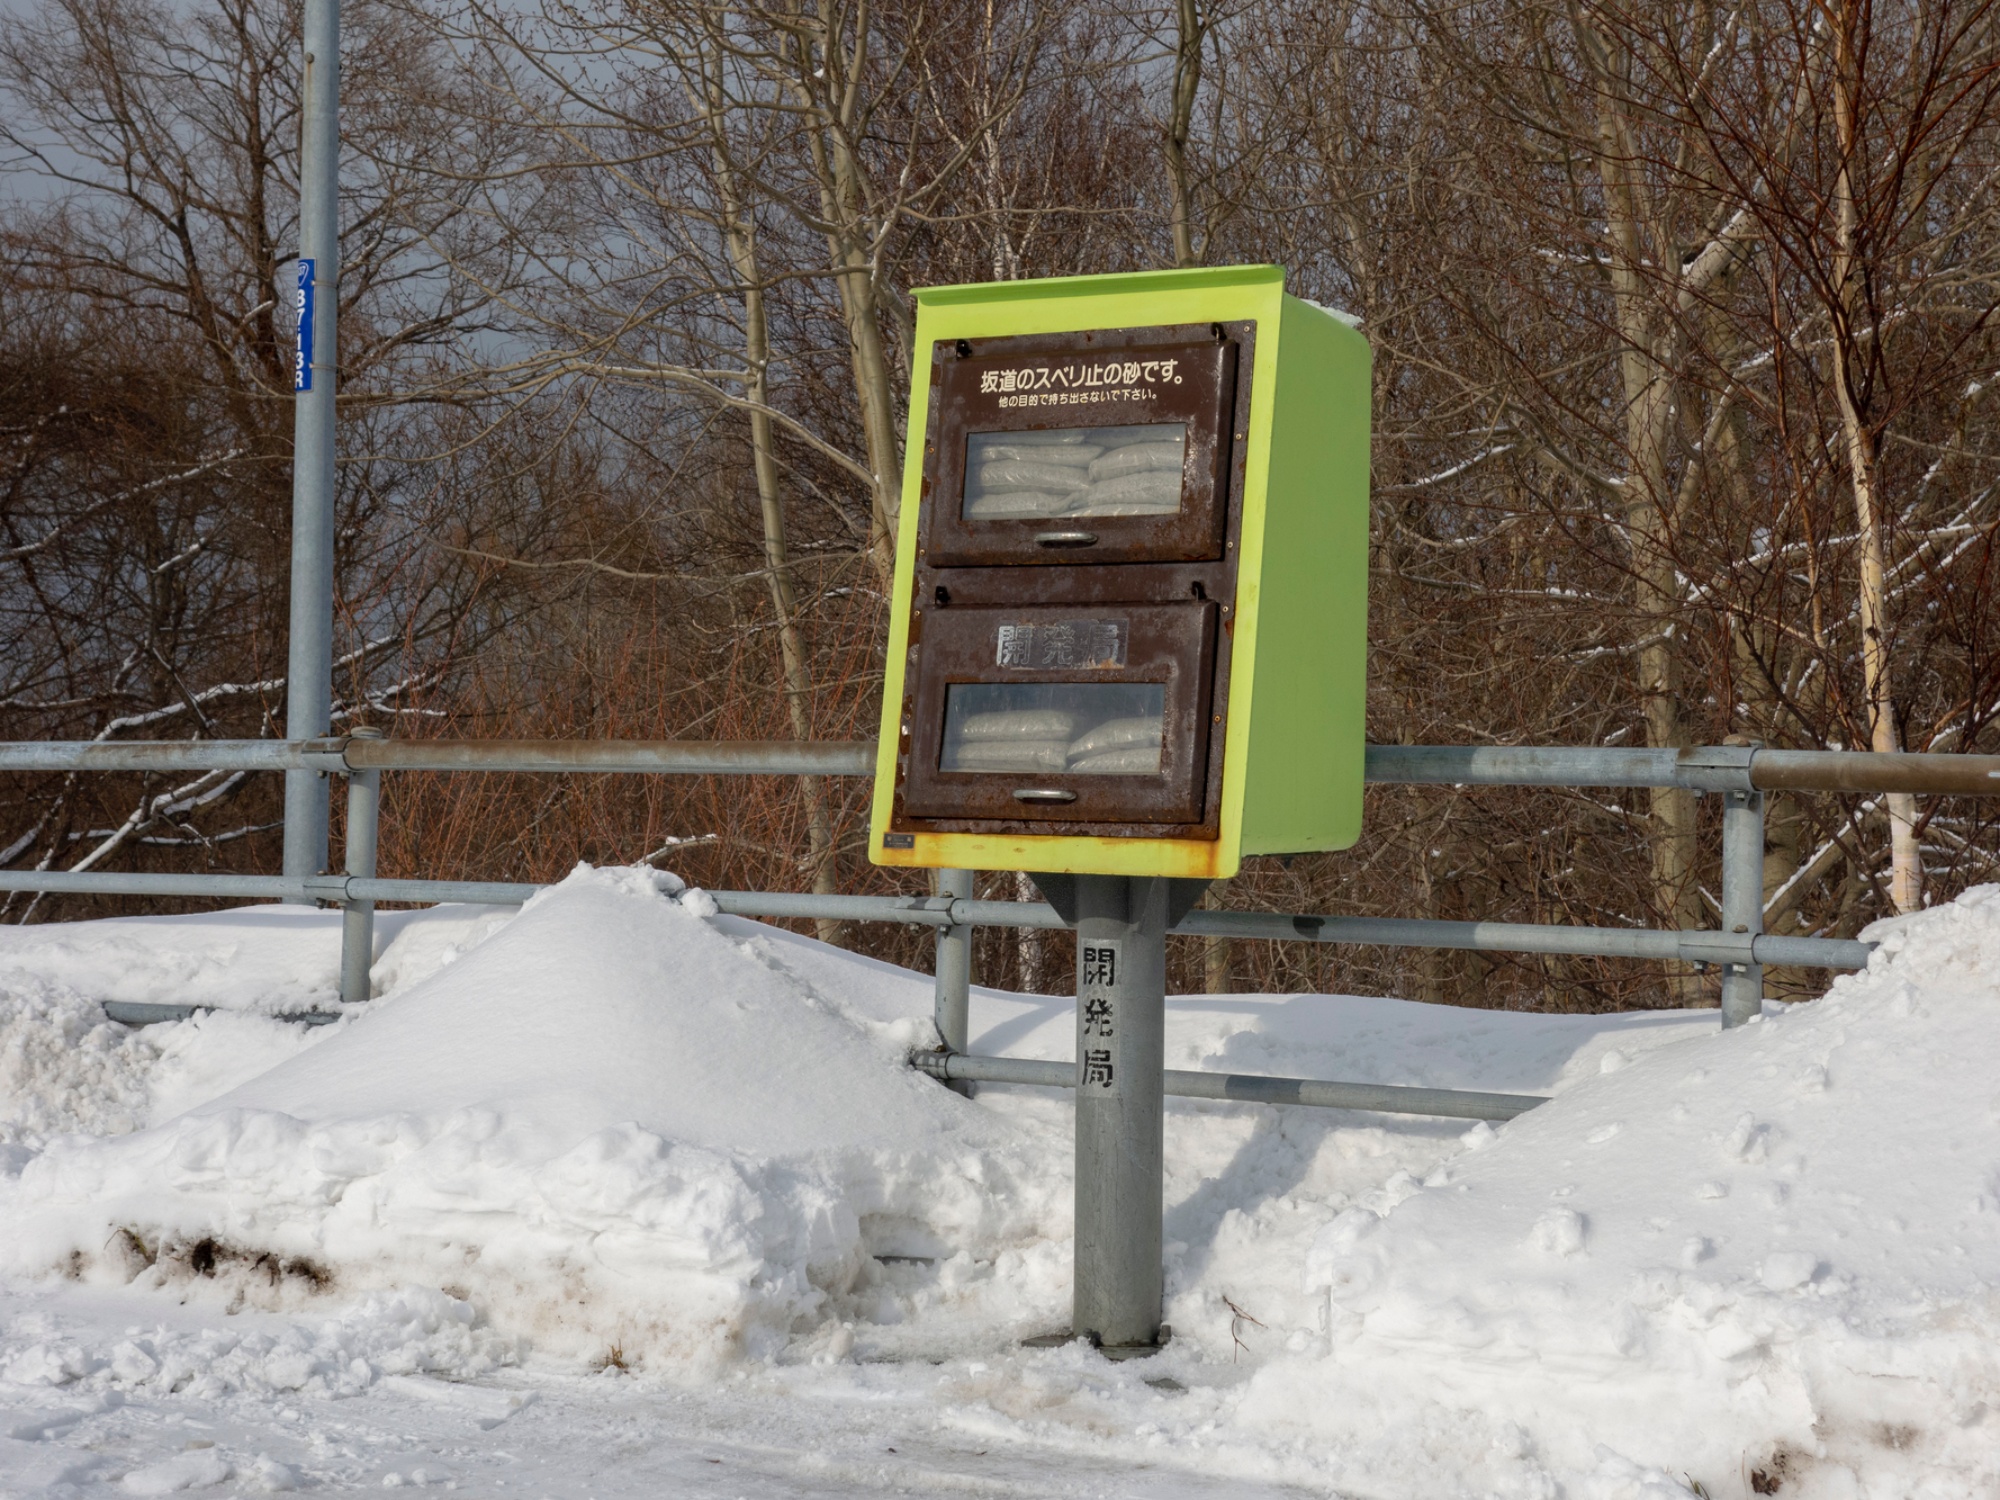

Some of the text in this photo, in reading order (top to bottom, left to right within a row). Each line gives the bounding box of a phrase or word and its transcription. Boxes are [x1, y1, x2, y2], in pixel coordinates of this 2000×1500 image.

[980, 358, 1183, 393] 坂道のスベリ止の砂です。
[998, 388, 1157, 408] 他の目的で持ち出さないで下さい。
[1082, 947, 1116, 1089] 開発局
